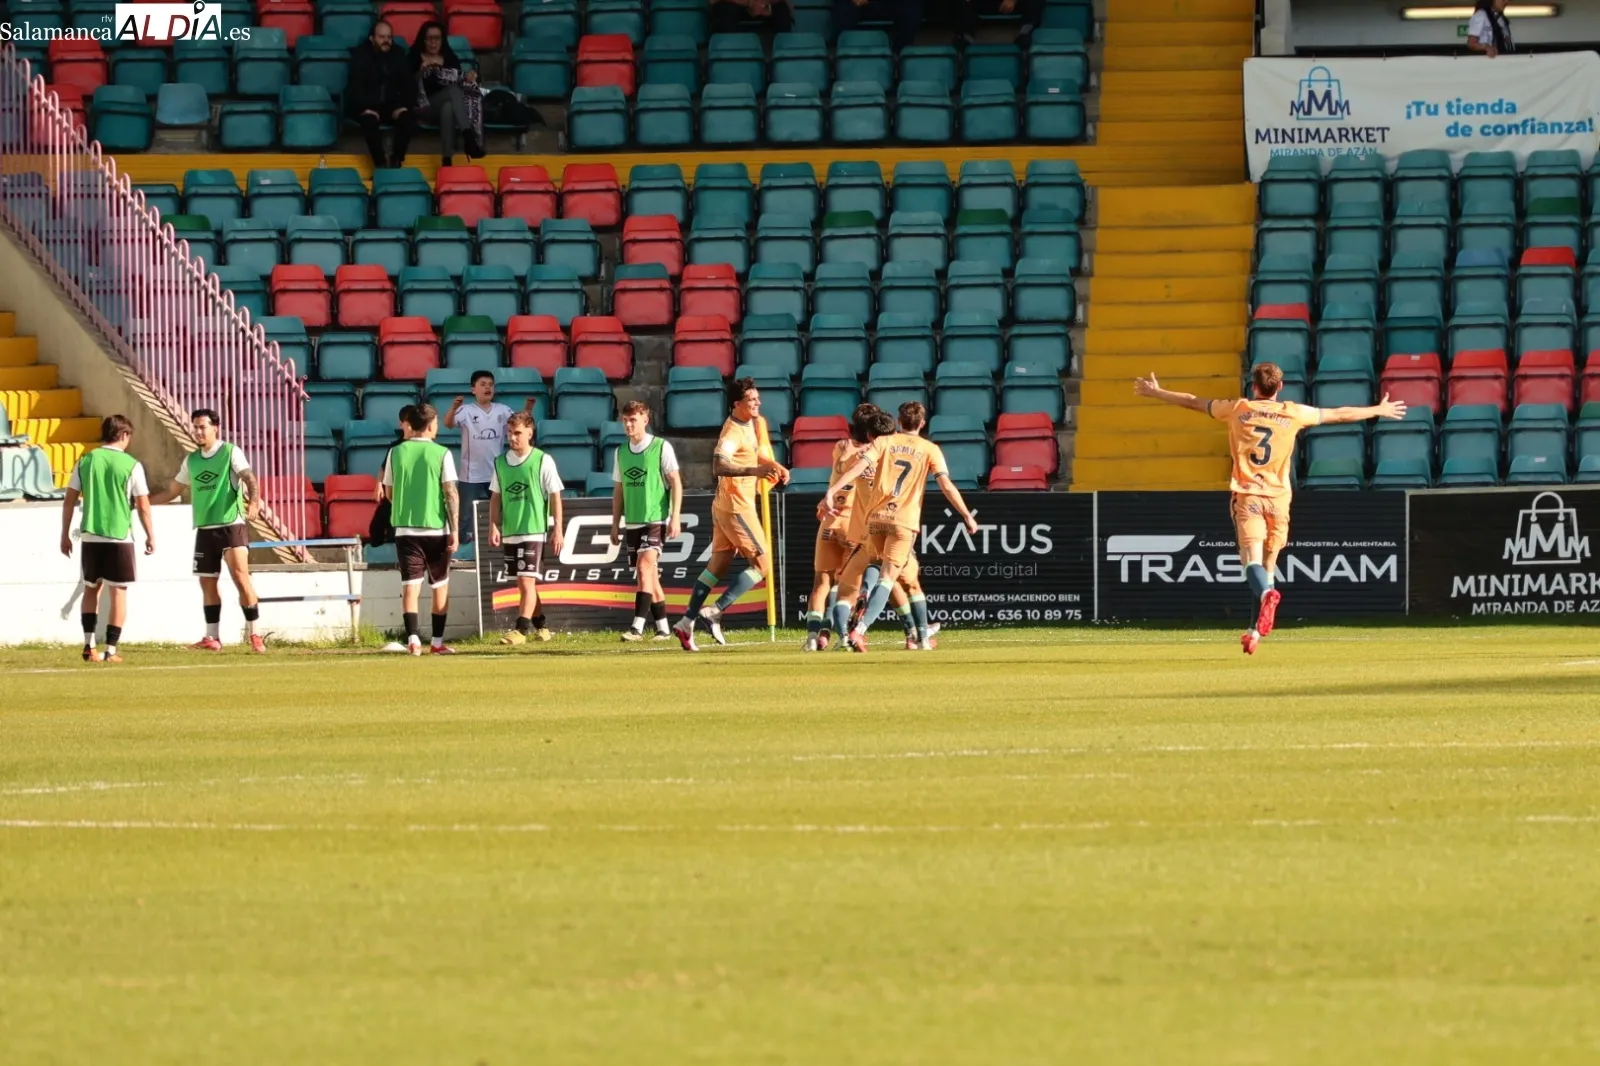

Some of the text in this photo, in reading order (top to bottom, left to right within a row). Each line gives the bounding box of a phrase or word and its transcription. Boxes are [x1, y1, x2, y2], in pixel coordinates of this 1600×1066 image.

[1406, 98, 1517, 120] ¡Tu tienda
[1254, 126, 1390, 145] MINIMARKET
[1445, 117, 1594, 138] de confianza!
[1269, 147, 1324, 158] MIRANDA
[1327, 147, 1343, 157] DE
[1249, 426, 1273, 466] 3
[893, 459, 912, 496] 7
[918, 562, 1038, 580] reativa y digital
[997, 609, 1022, 621] 636
[1025, 609, 1040, 621] 10
[1044, 609, 1062, 621] 89
[1065, 609, 1082, 621] 75
[1471, 601, 1549, 616] MIRANDA
[1553, 600, 1575, 614] DE
